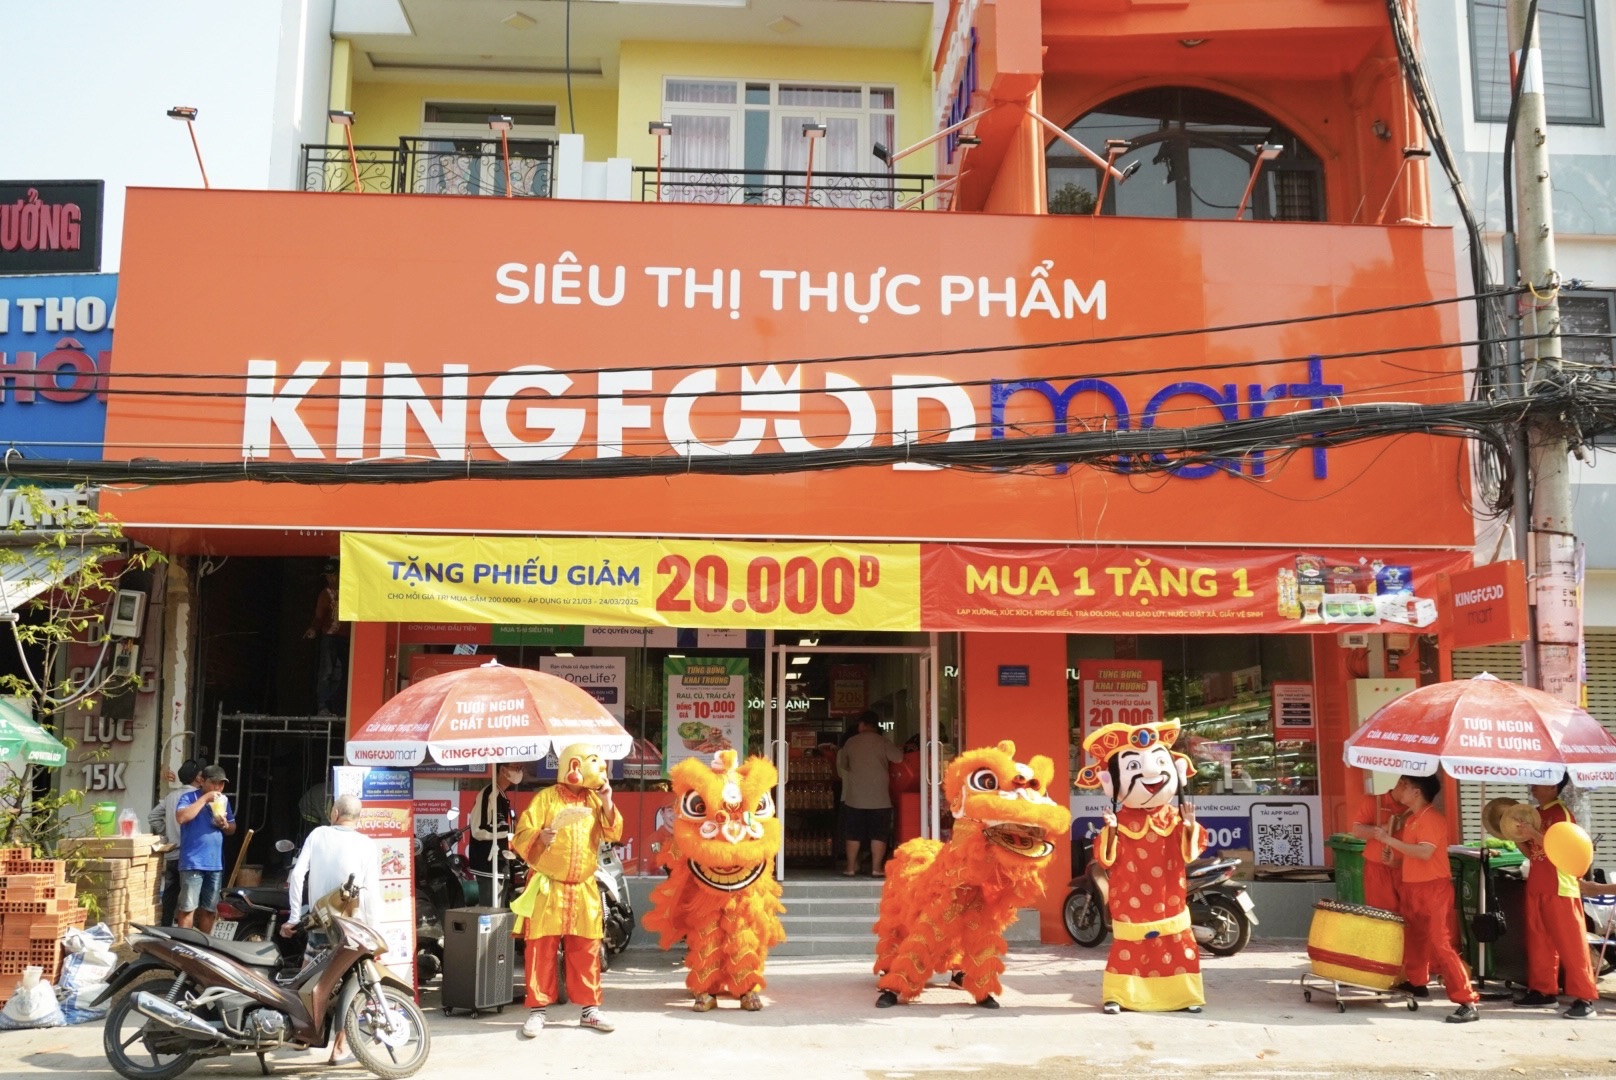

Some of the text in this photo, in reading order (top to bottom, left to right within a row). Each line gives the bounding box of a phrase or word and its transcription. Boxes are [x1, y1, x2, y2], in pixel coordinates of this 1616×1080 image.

[495, 250, 1107, 324] SIÊU THỊ THỰC PHẨM
[387, 555, 464, 587] TẶNG
[473, 555, 558, 586] PHIẾU
[567, 559, 640, 586] GIẢM
[966, 558, 1254, 605] MUA 1 TẶNG 1
[528, 596, 539, 604] ÁP
[539, 598, 562, 606] DỤNG
[599, 598, 639, 606] 24/03/2025
[1455, 584, 1504, 607] KINGFOOD
[489, 699, 525, 713] NGON
[693, 700, 736, 719] 10.000
[1496, 719, 1534, 733] NGON
[81, 763, 127, 791] 15K
